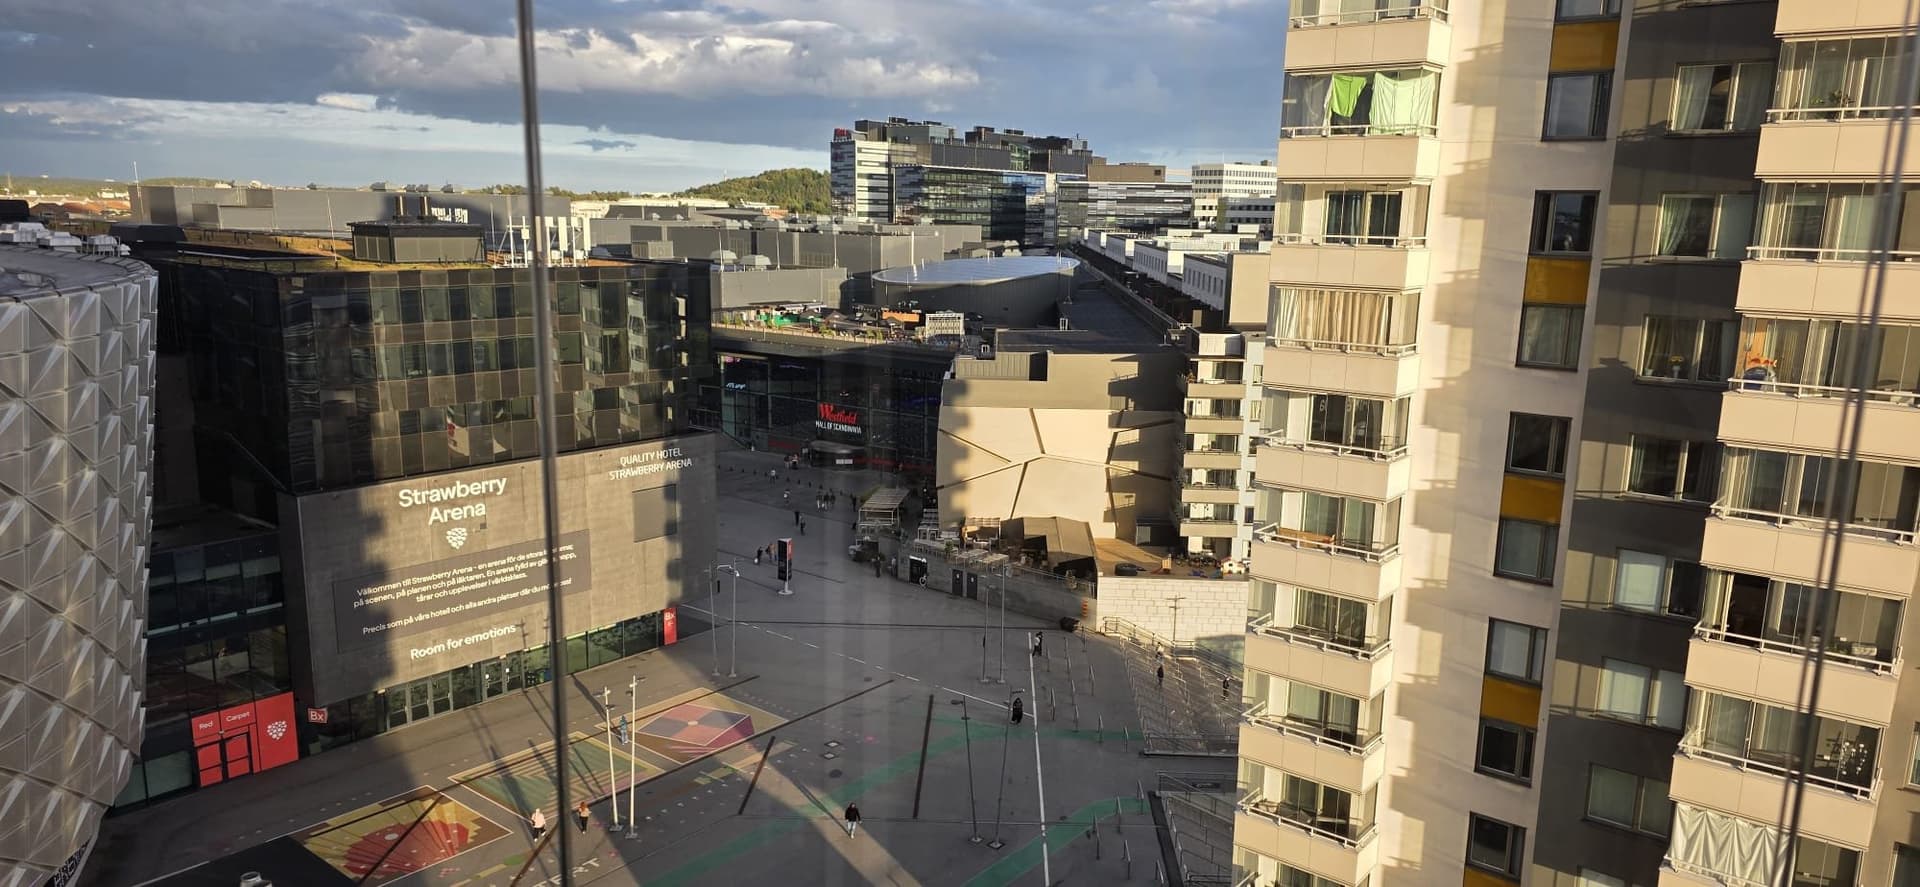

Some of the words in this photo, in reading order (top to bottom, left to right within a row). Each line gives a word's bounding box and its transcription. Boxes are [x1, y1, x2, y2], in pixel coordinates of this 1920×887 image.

[819, 403, 857, 424] Westfield
[620, 451, 655, 467] QUALITY
[656, 447, 683, 460] HOTEL
[609, 462, 665, 480] STRAWBERRY
[666, 458, 692, 470] ARENA
[399, 477, 507, 507] Strawberry
[428, 502, 486, 525] Arena
[357, 582, 402, 596] Välkommen
[402, 578, 411, 587] till
[412, 570, 452, 585] Strawberry
[452, 566, 473, 576] Arena
[487, 559, 506, 568] arena
[506, 555, 516, 563] för
[516, 553, 526, 561] de
[353, 599, 364, 609] på
[396, 588, 406, 599] på
[406, 585, 432, 597] planen
[432, 580, 446, 590] och
[447, 577, 456, 588] på
[486, 569, 496, 577] En
[496, 566, 514, 575] arena
[416, 593, 434, 602] tårar
[434, 589, 449, 598] och
[362, 623, 386, 635] Precis
[386, 619, 403, 629] som
[403, 615, 413, 627] på
[414, 613, 430, 622] våra
[430, 607, 451, 618] hotell
[451, 603, 465, 613] och
[465, 600, 477, 609] alla
[477, 597, 497, 607] andra
[520, 587, 531, 596] där
[531, 585, 540, 593] du
[410, 643, 445, 660] Room
[447, 638, 465, 650] for
[464, 624, 517, 645] emotions
[199, 720, 213, 730] Red
[225, 711, 250, 722] Carpet
[310, 711, 324, 721] Bx
